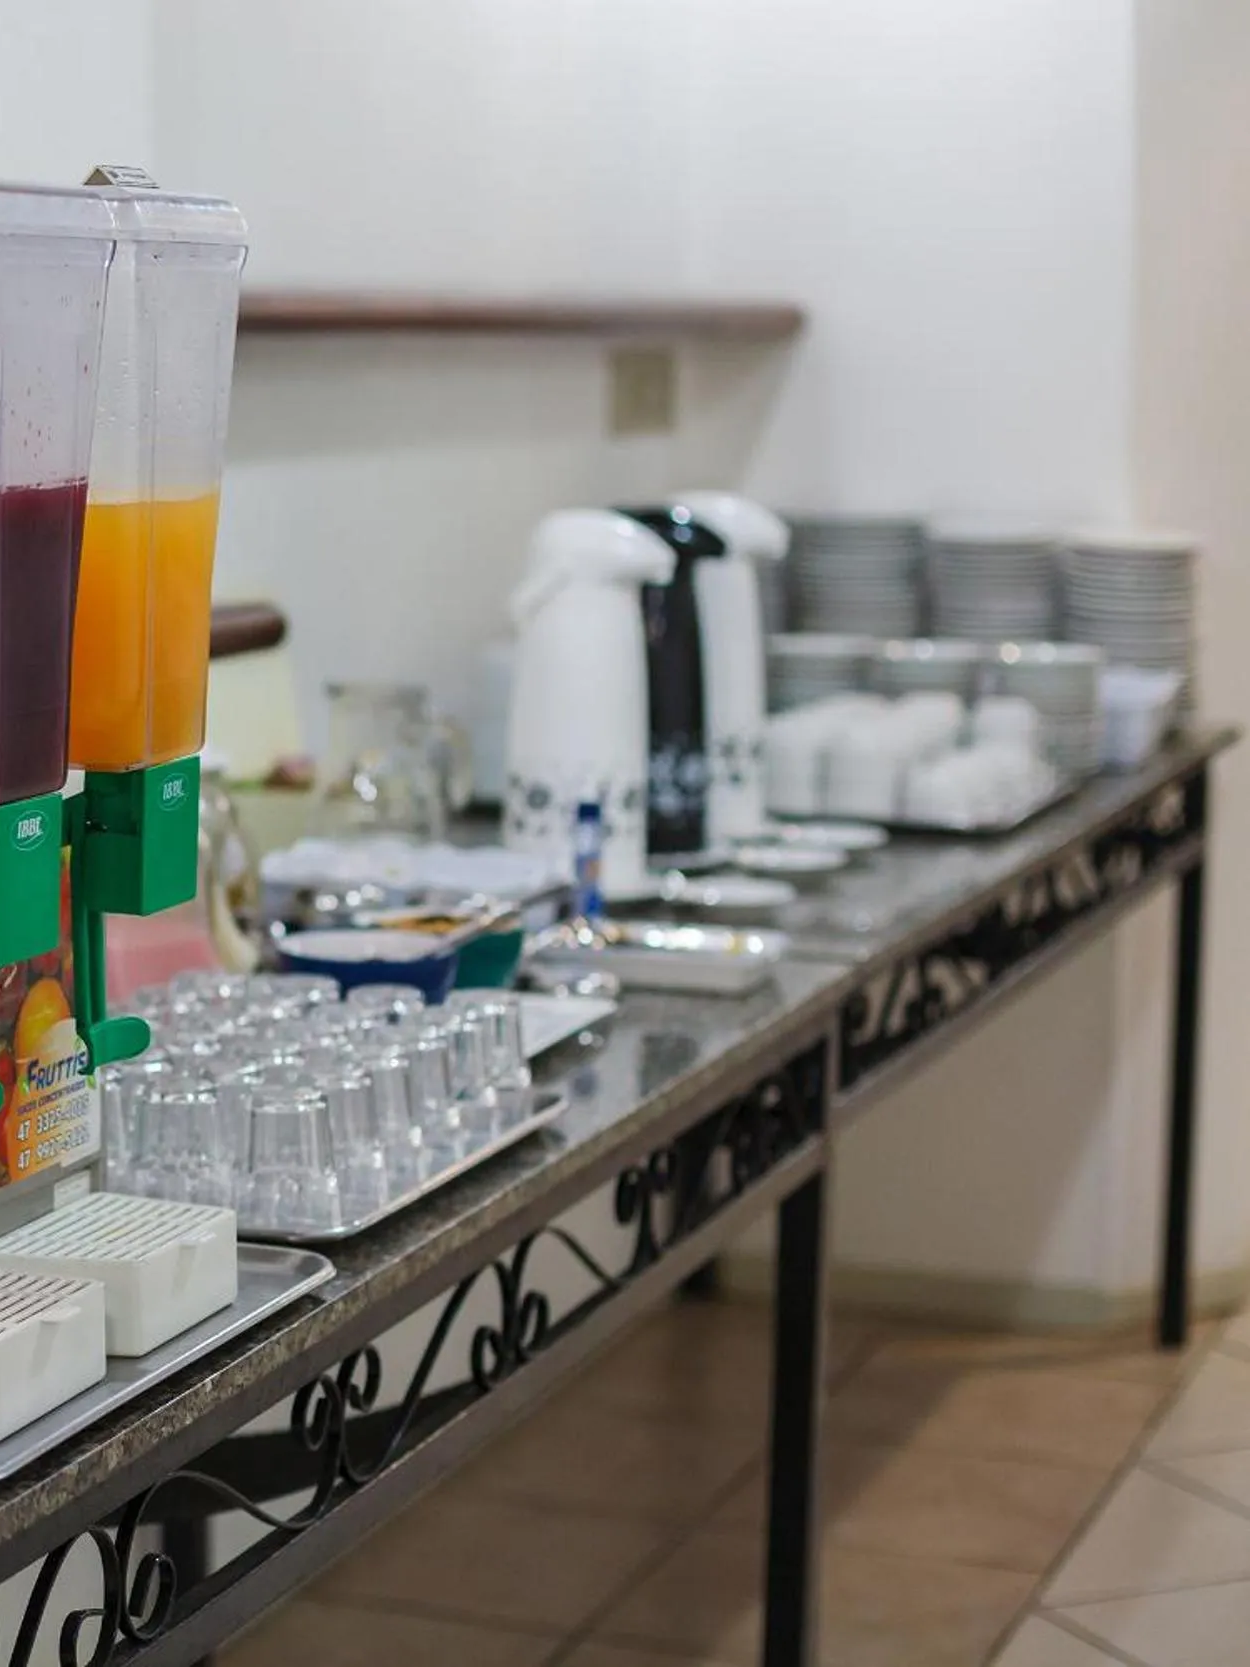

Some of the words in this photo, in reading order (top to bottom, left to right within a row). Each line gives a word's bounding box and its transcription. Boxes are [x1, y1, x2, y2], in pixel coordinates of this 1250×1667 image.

[162, 779, 184, 801] IBBL
[17, 816, 43, 840] IBBL
[16, 1119, 31, 1141] 47
